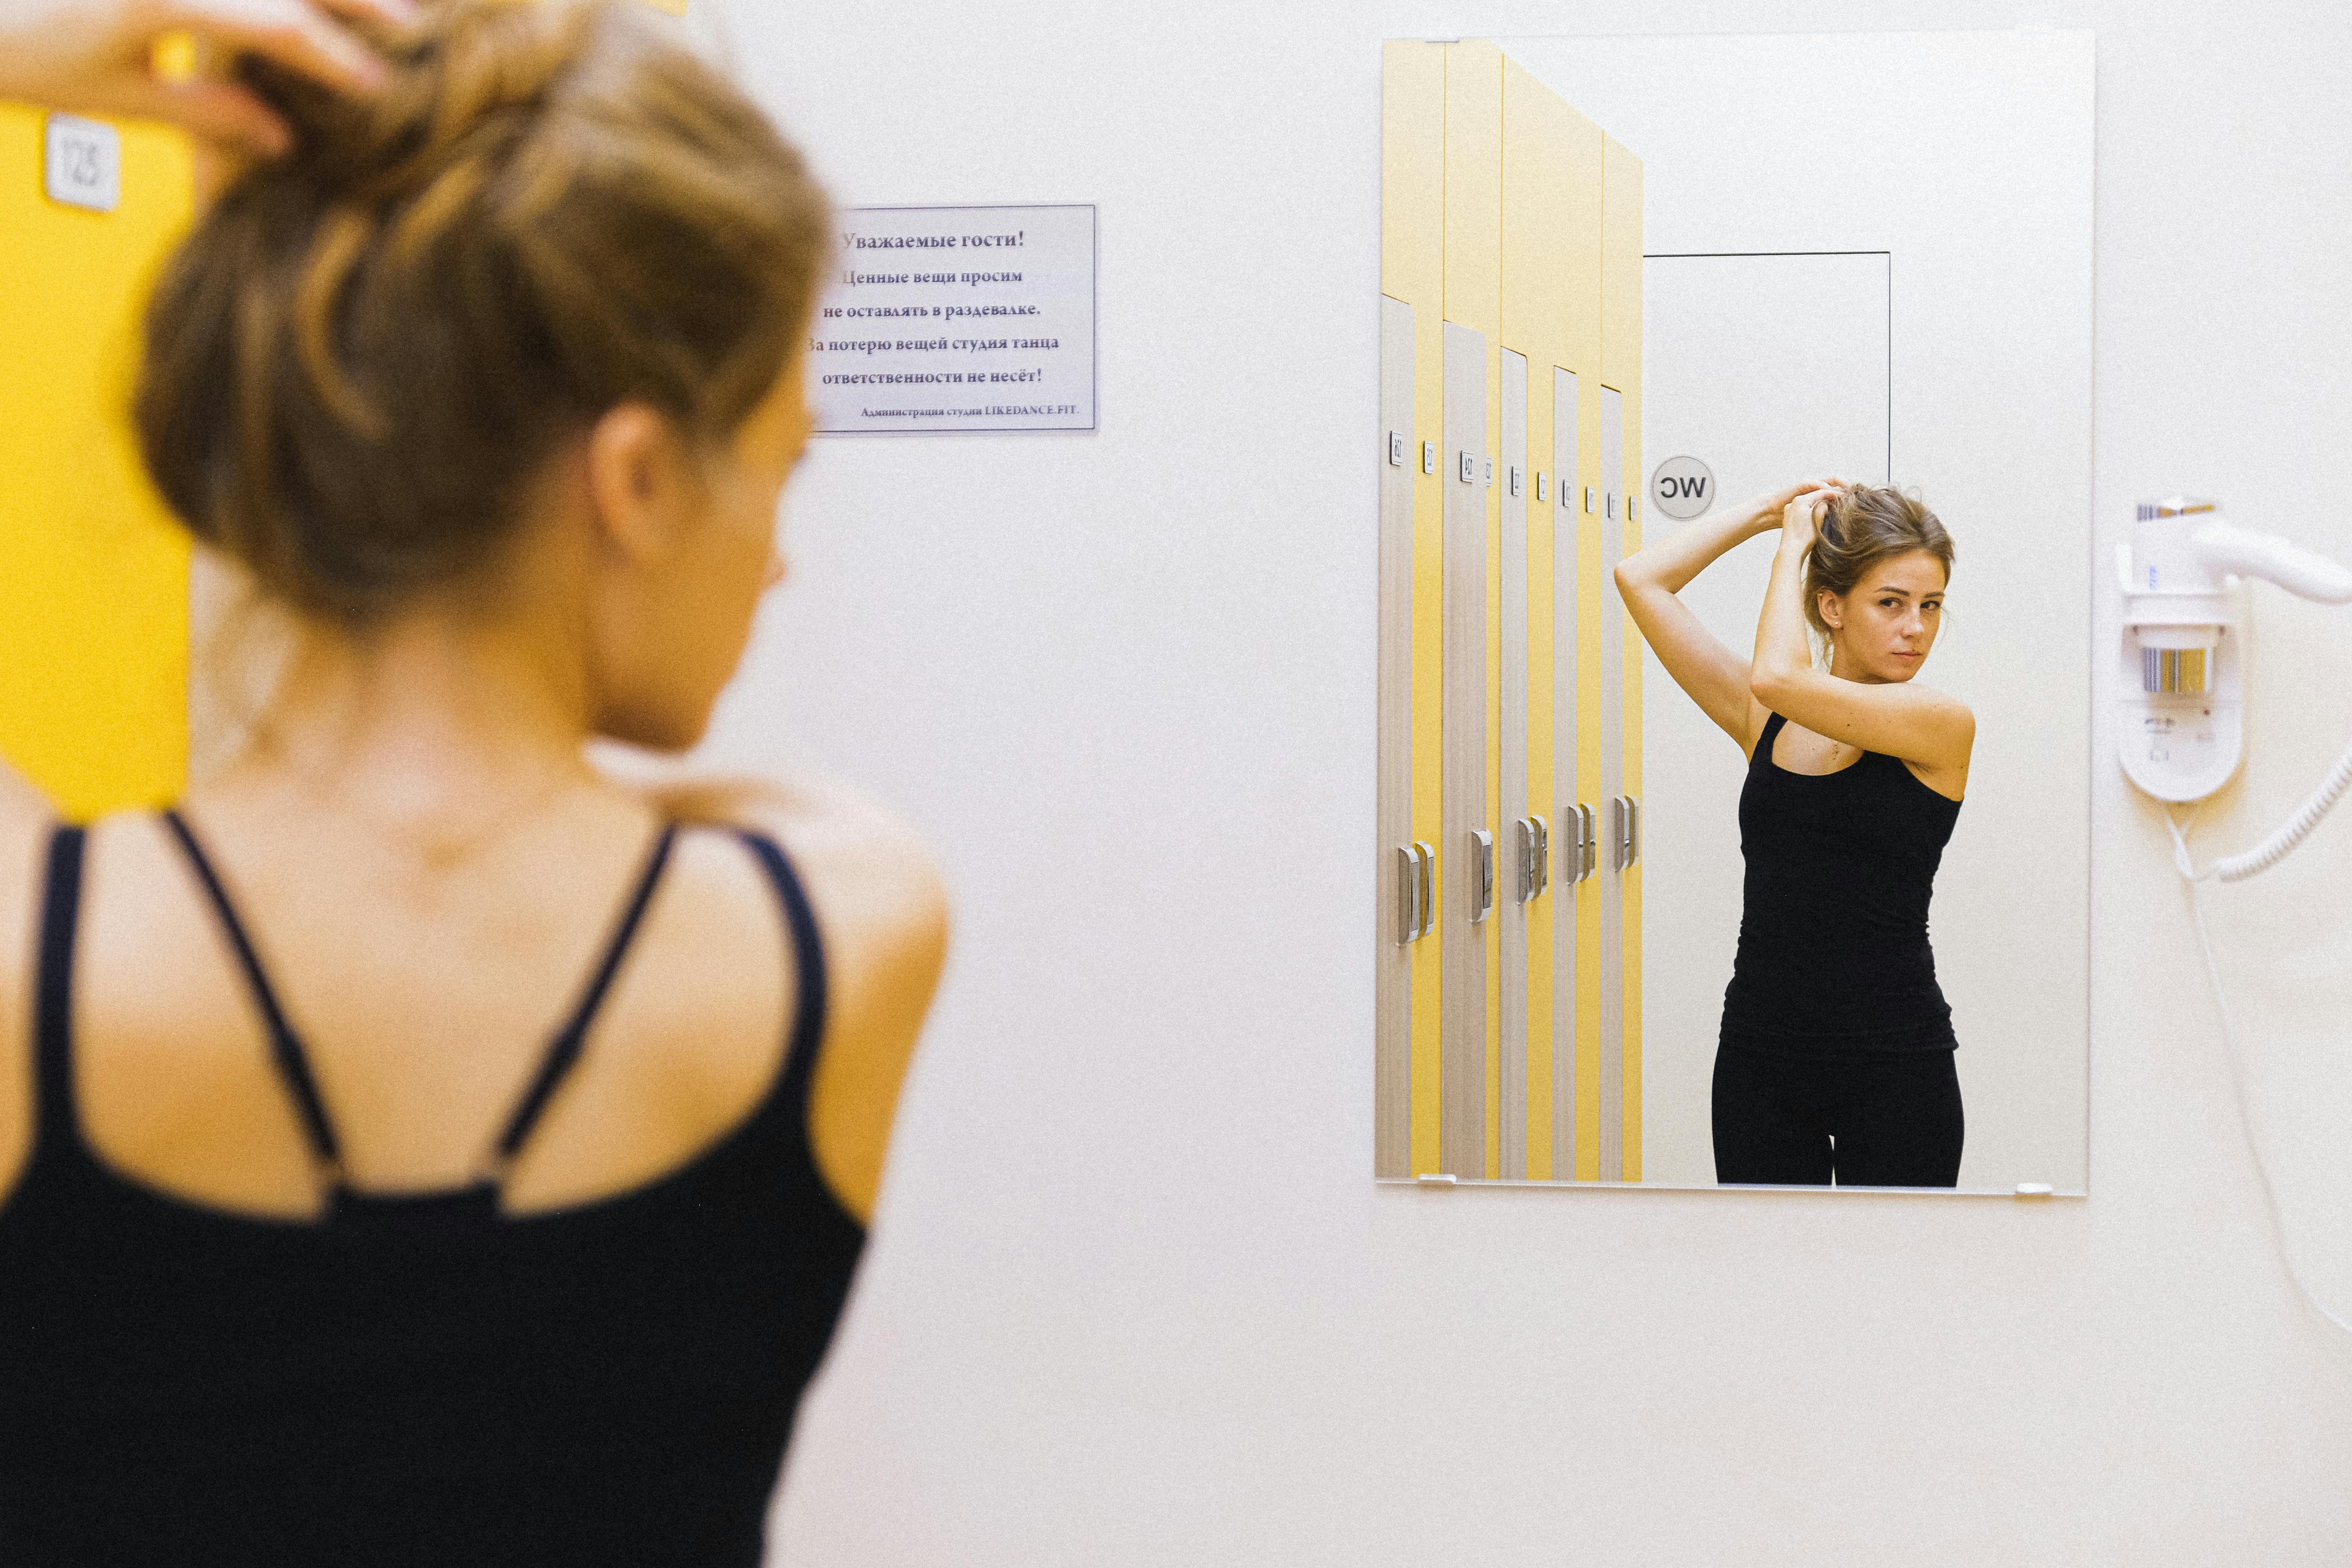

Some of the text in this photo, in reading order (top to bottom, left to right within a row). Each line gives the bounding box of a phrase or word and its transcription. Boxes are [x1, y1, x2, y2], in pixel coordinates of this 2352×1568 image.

[843, 230, 1024, 249] Уважаемые гости!
[843, 270, 1023, 287] Ценные вещи просим
[824, 305, 1041, 321] не оставлять в раздевалке.
[829, 340, 892, 355] потерю
[896, 337, 948, 353] вещей
[952, 339, 1008, 352] студия
[1011, 338, 1060, 351] танца
[822, 368, 1042, 385] ответственности не несёт!
[861, 407, 944, 419] Администрация
[946, 408, 982, 418] студии
